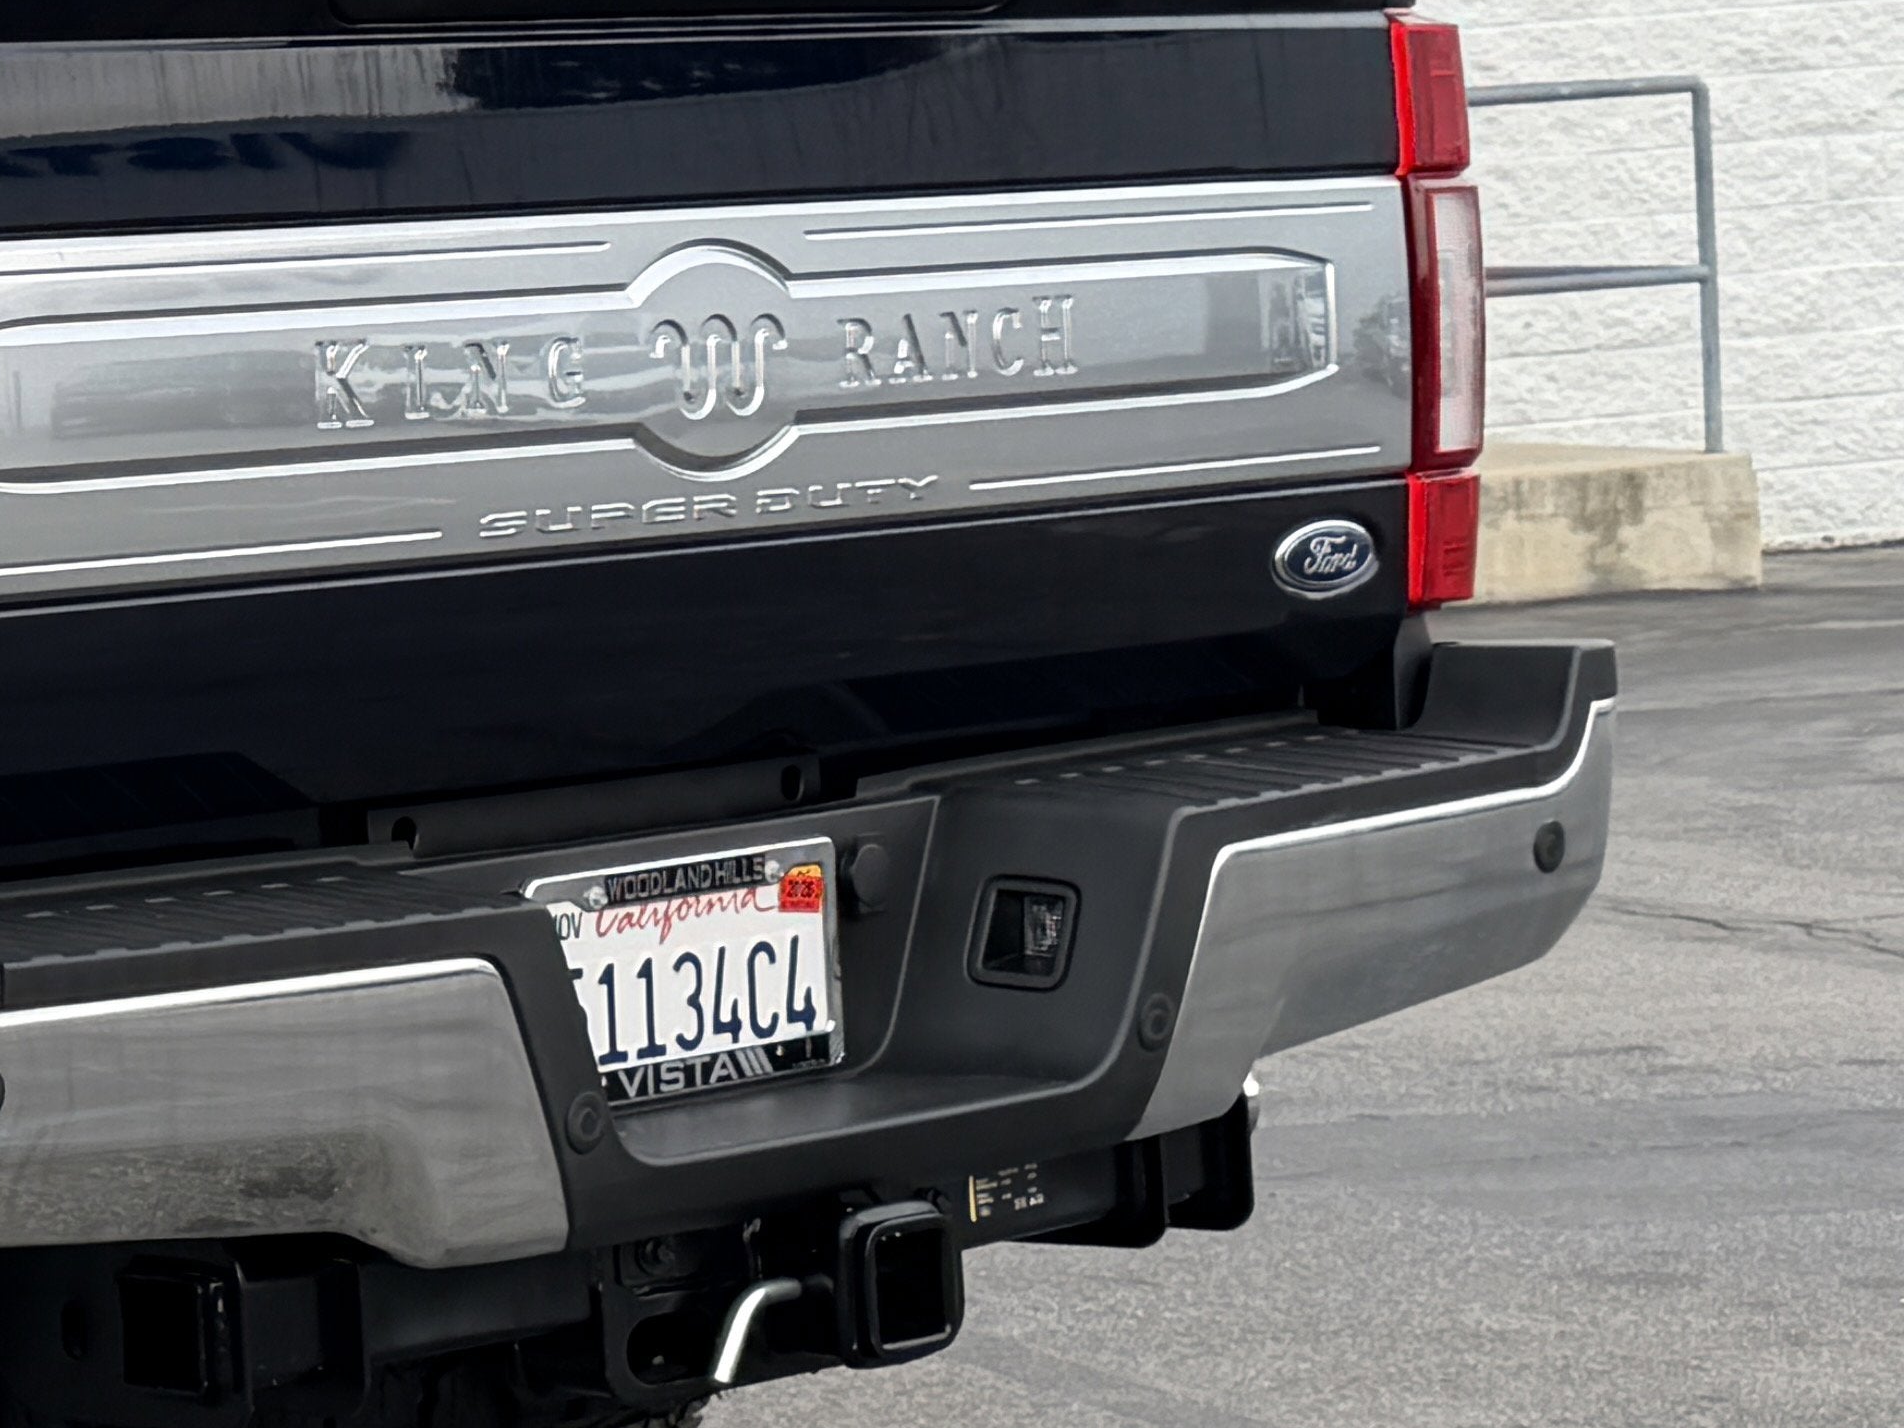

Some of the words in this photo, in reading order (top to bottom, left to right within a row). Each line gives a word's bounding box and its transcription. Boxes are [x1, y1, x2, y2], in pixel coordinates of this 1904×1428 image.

[313, 335, 586, 429] KING
[837, 295, 1078, 388] RANCH
[478, 492, 738, 538] SUPER
[755, 474, 939, 514] DUTY
[1303, 535, 1358, 576] Ford
[606, 863, 712, 902] WOODLAND
[714, 855, 765, 887] HILLS
[595, 888, 776, 945] California
[568, 935, 818, 1065] 1134C4
[618, 1052, 739, 1098] VISTA
